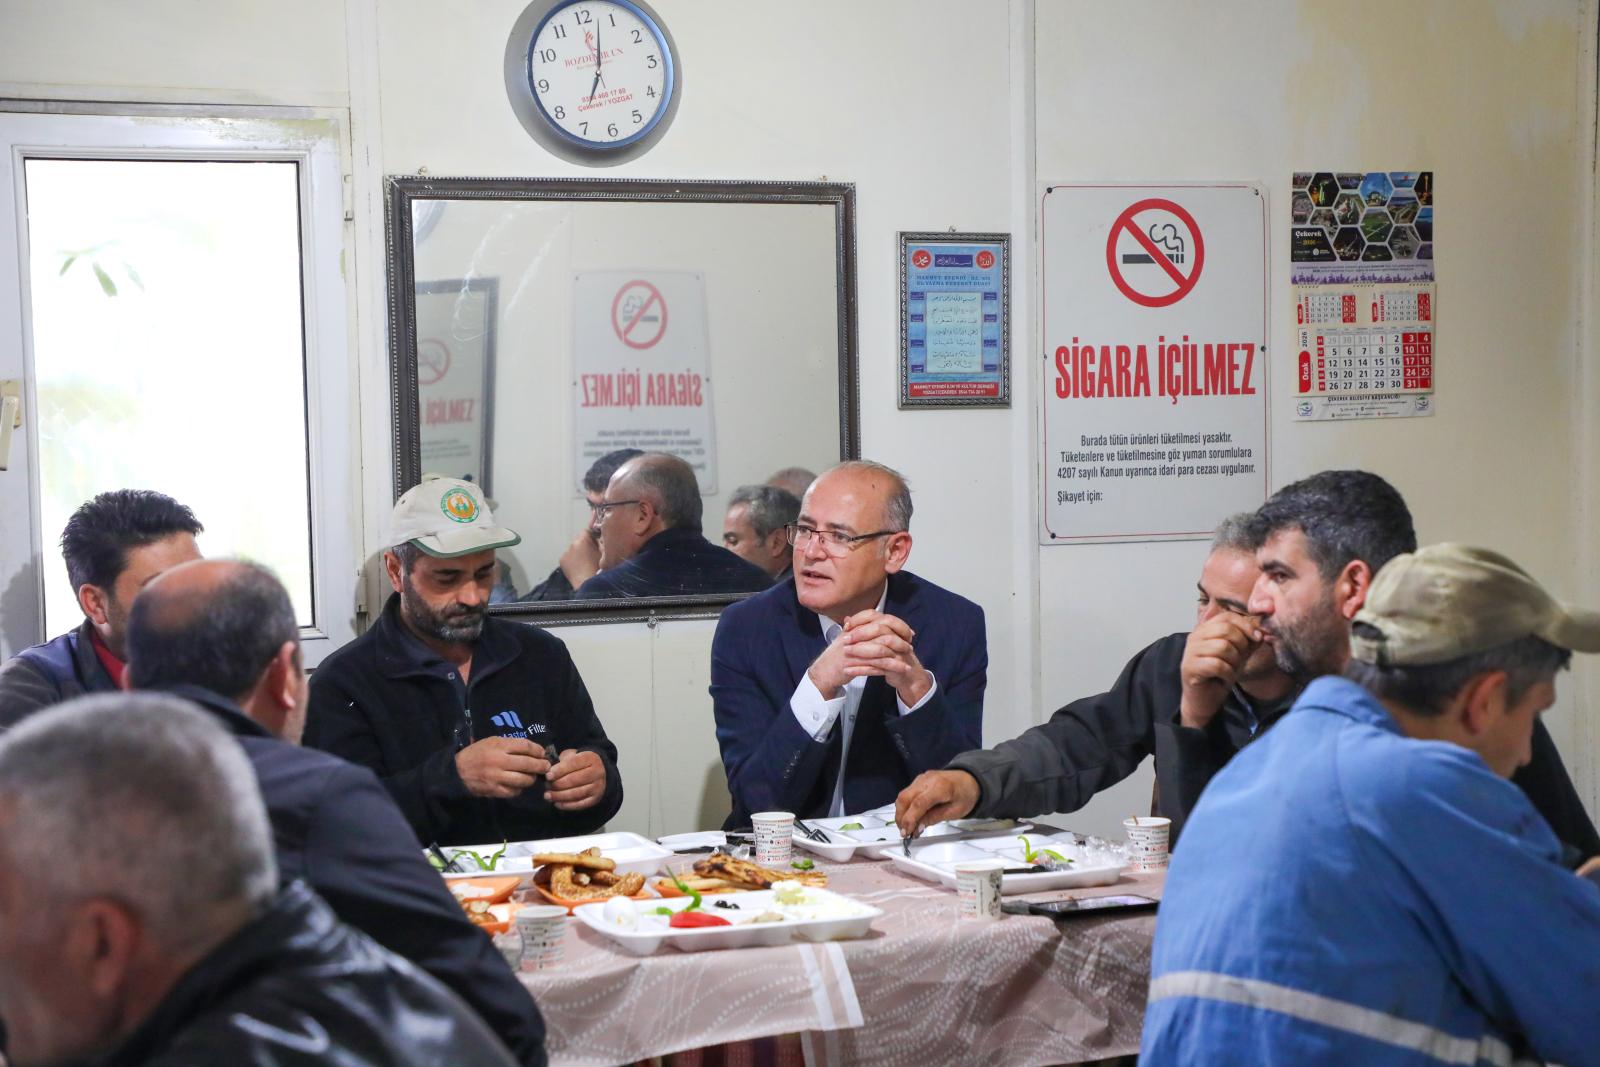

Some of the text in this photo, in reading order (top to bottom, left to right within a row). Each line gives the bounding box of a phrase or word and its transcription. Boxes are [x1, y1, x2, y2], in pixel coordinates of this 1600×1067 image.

[574, 10, 592, 25] 12
[608, 13, 616, 27] 1
[553, 24, 567, 39] 11
[631, 29, 643, 44] 2
[540, 48, 556, 63] 10
[647, 55, 657, 68] 3
[538, 79, 549, 93] 9
[646, 85, 656, 98] 4
[608, 94, 633, 104] YOZGAT
[554, 106, 566, 119] 8
[632, 109, 643, 123] 5
[579, 122, 589, 135] 7
[607, 124, 618, 137] 6
[1295, 231, 1322, 239] Çekerek
[1409, 334, 1414, 342] 3
[1423, 334, 1429, 342] 4
[1332, 348, 1337, 356] 5
[1395, 346, 1400, 354] 9
[1405, 346, 1415, 354] 10
[1344, 359, 1353, 367] 13
[1375, 358, 1384, 366] 15
[1406, 357, 1415, 365] 17
[1055, 337, 1151, 399] SİGARA
[1158, 335, 1256, 405] İÇİLMEZ
[1359, 370, 1368, 378] 21
[1391, 369, 1400, 377] 23
[1422, 368, 1429, 376] 25
[1329, 382, 1339, 390] 26
[1344, 382, 1352, 390] 27
[1359, 381, 1368, 389] 28
[1375, 381, 1384, 389] 29
[1081, 432, 1232, 446] Burada tütün ürünleri tüketilmesi yasaktır.
[1061, 447, 1252, 463] Tüketenlere ve tüketilmesine göz yuman sorumlulara
[1057, 463, 1255, 480] 4207 sayılı Kanun uyarınca idari para cezası uygulanır.
[1057, 490, 1102, 505] Şikayet için:
[527, 723, 546, 735] Filte
